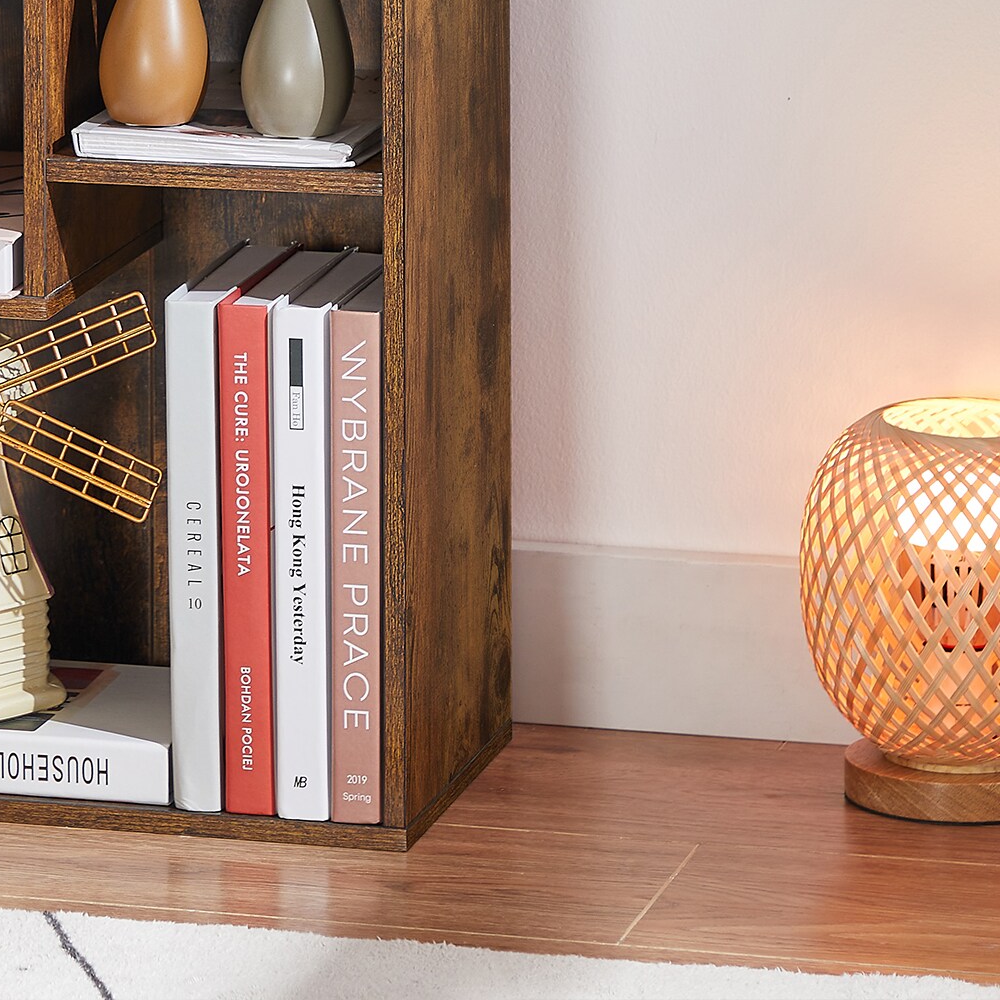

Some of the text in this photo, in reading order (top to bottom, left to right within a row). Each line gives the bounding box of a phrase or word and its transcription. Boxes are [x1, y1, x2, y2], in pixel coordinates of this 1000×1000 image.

[292, 392, 300, 427] Fan Ho
[233, 352, 251, 576] THE CURE: UROJONELATA
[186, 501, 202, 586] CEREAL
[288, 485, 307, 665] Hong Kong Yesterday
[341, 340, 370, 730] WYBRANE PRACE
[188, 598, 202, 610] 10
[240, 666, 253, 771] BOHDAN POCIEJ
[342, 791, 372, 804] Spring
[346, 774, 368, 785] 2019
